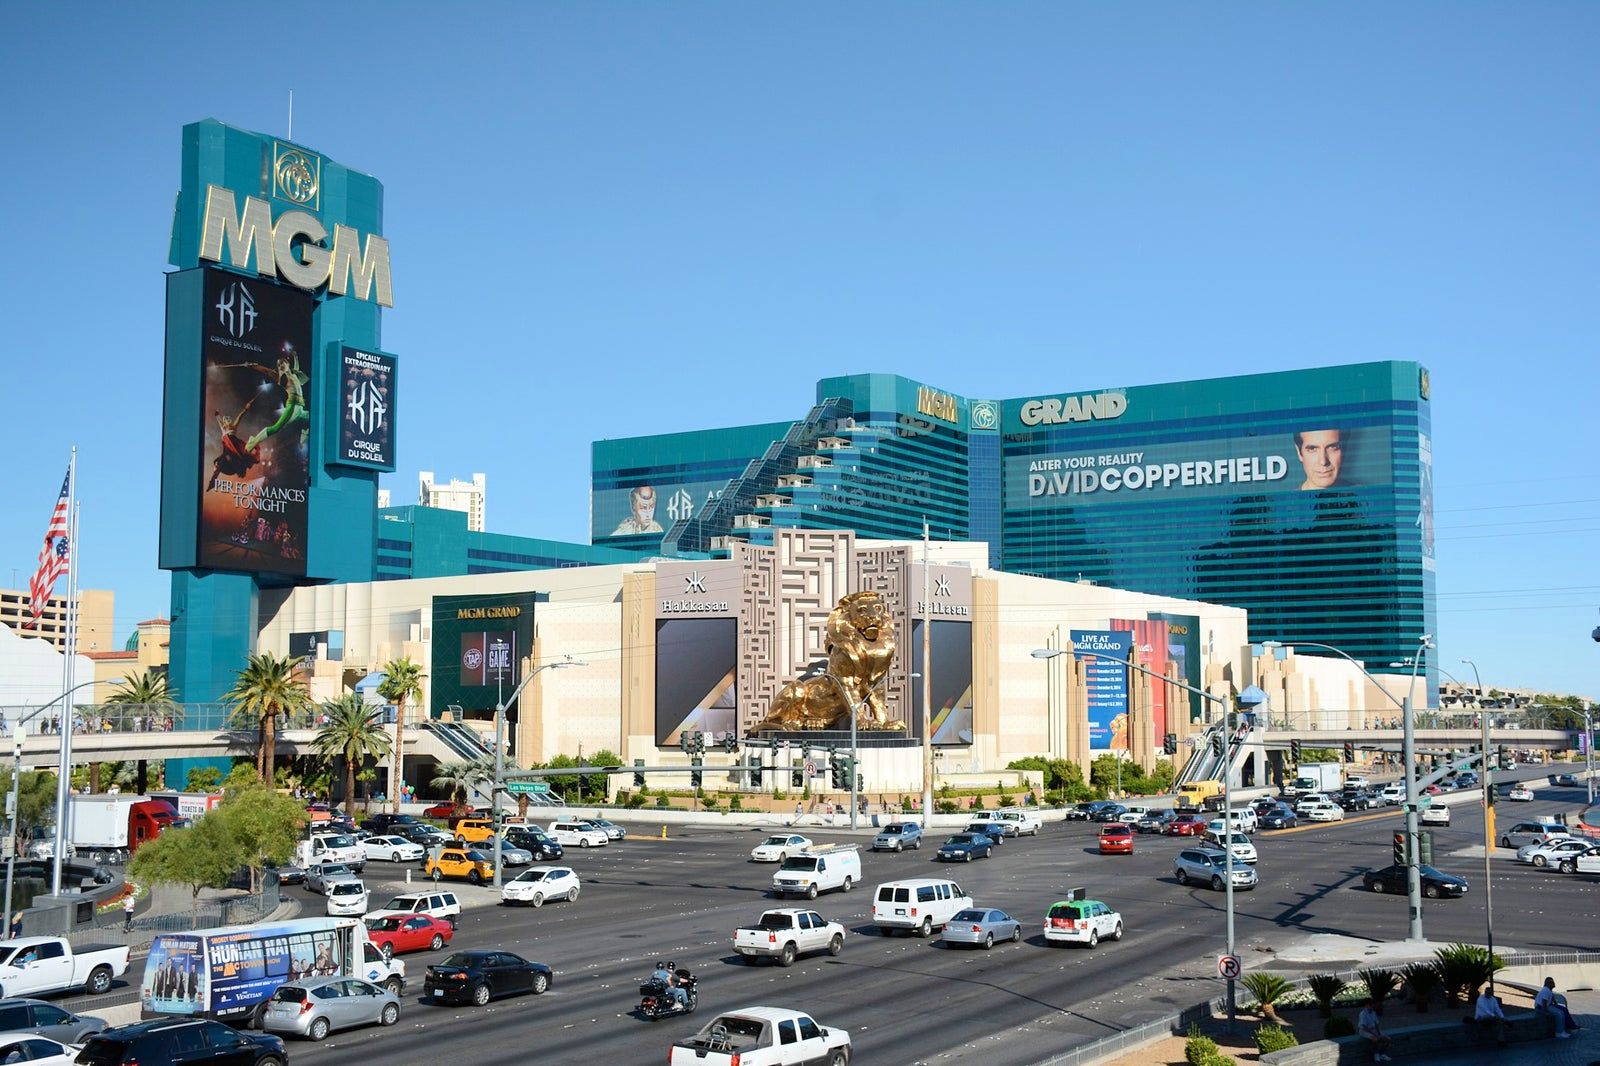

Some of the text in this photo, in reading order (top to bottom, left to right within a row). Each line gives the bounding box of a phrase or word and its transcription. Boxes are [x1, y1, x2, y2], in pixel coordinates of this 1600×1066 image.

[200, 184, 394, 308] MGM
[210, 335, 233, 347] CIRQUE
[233, 340, 243, 348] DU
[344, 356, 392, 373] EXTRAORDINARY
[356, 351, 381, 364] EPICALLY
[917, 385, 958, 424] MGM
[1019, 393, 1128, 426] GRAND
[353, 439, 381, 453] CIRQUE
[348, 449, 385, 463] DU SOLEIL
[1029, 451, 1144, 472] ALTER YOUR REALITY
[214, 478, 306, 503] PERFORMANCES
[234, 494, 288, 514] TONIGHT
[458, 605, 521, 619] MGM GRAND
[662, 599, 729, 613] Hakkasan
[1074, 641, 1121, 650] MGM GRAND
[1081, 634, 1110, 643] LIVE AT
[210, 940, 264, 964] HUMAN
